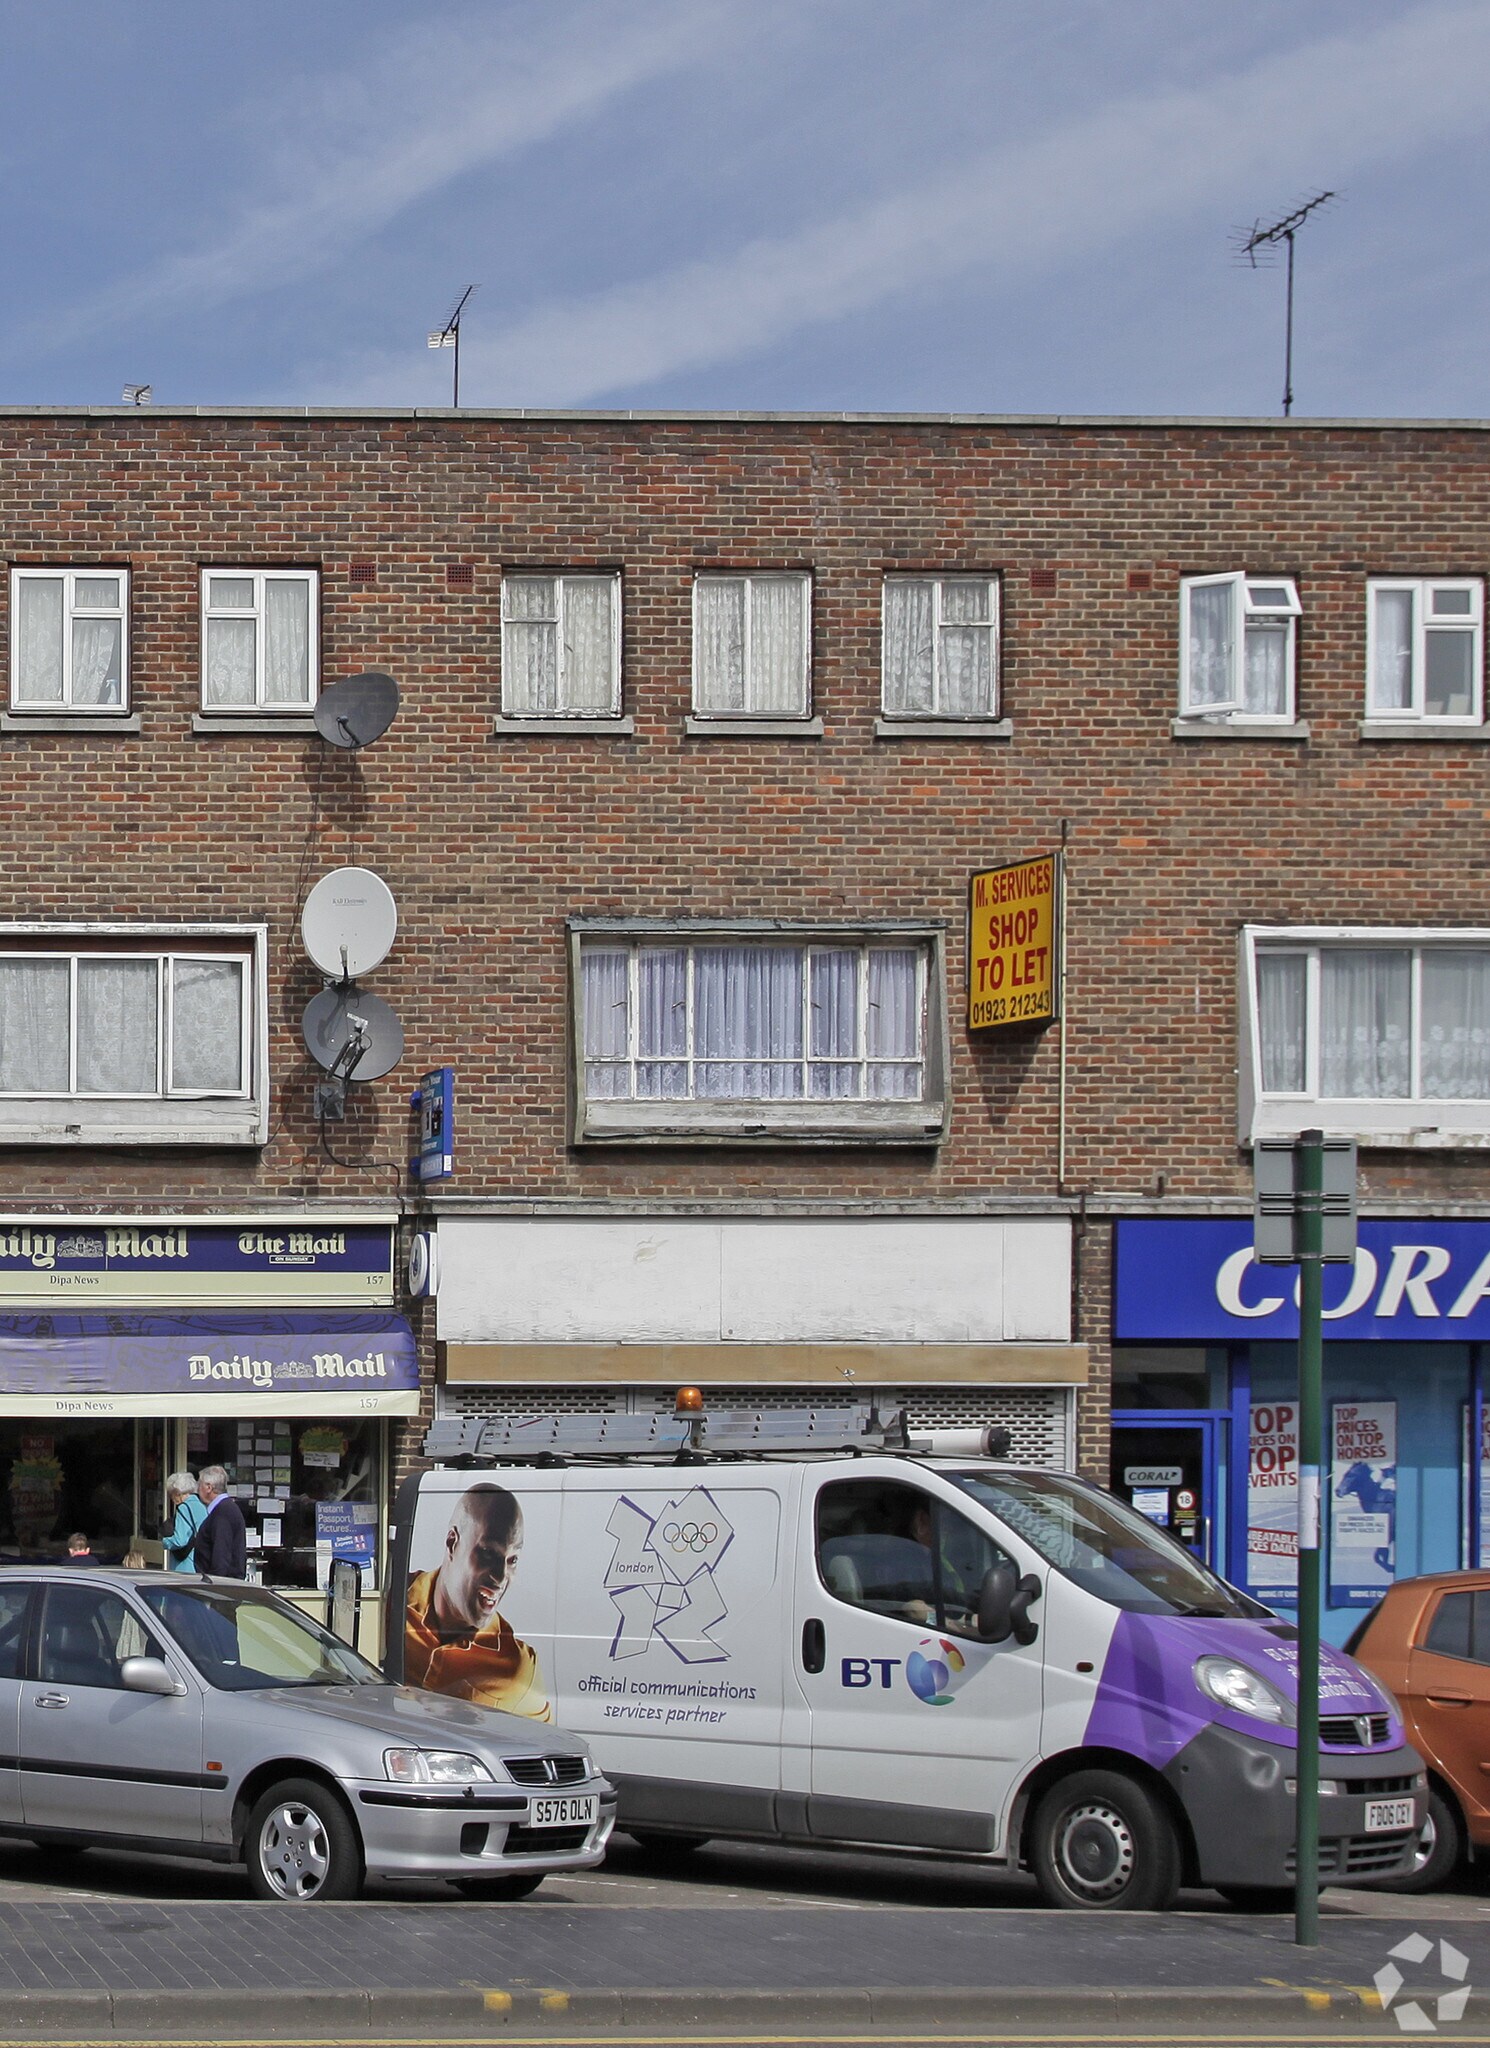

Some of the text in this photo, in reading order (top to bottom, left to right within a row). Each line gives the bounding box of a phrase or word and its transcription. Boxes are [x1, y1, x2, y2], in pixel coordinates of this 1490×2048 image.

[975, 863, 1050, 909] M. SERVICES
[988, 907, 1039, 951] SHOP
[976, 946, 1048, 993] TO LET
[972, 989, 1050, 1025] 01923 212343
[104, 1226, 189, 1258] Mail
[238, 1232, 346, 1255] The Mail
[50, 1275, 99, 1286] Dipa News
[366, 1276, 384, 1285] 157
[187, 1352, 387, 1388] Daily Mail
[56, 1401, 114, 1412] Dipa News
[359, 1398, 378, 1409] 157
[1335, 1407, 1358, 1421] TOP
[1336, 1419, 1378, 1434] PRICES
[1278, 1433, 1296, 1445] ON
[1337, 1432, 1383, 1447] ON TOP
[1337, 1445, 1387, 1460] HORSES
[1128, 1471, 1171, 1481] CORAL
[1179, 1494, 1191, 1505] 18
[317, 1504, 344, 1513] Instant
[318, 1513, 351, 1523] Passport
[1270, 1541, 1298, 1555] DAILY
[615, 1561, 654, 1573] london
[841, 1658, 901, 1688] BT
[578, 1675, 757, 1699] official communications
[604, 1702, 727, 1725] services partner
[536, 1799, 568, 1823] S576
